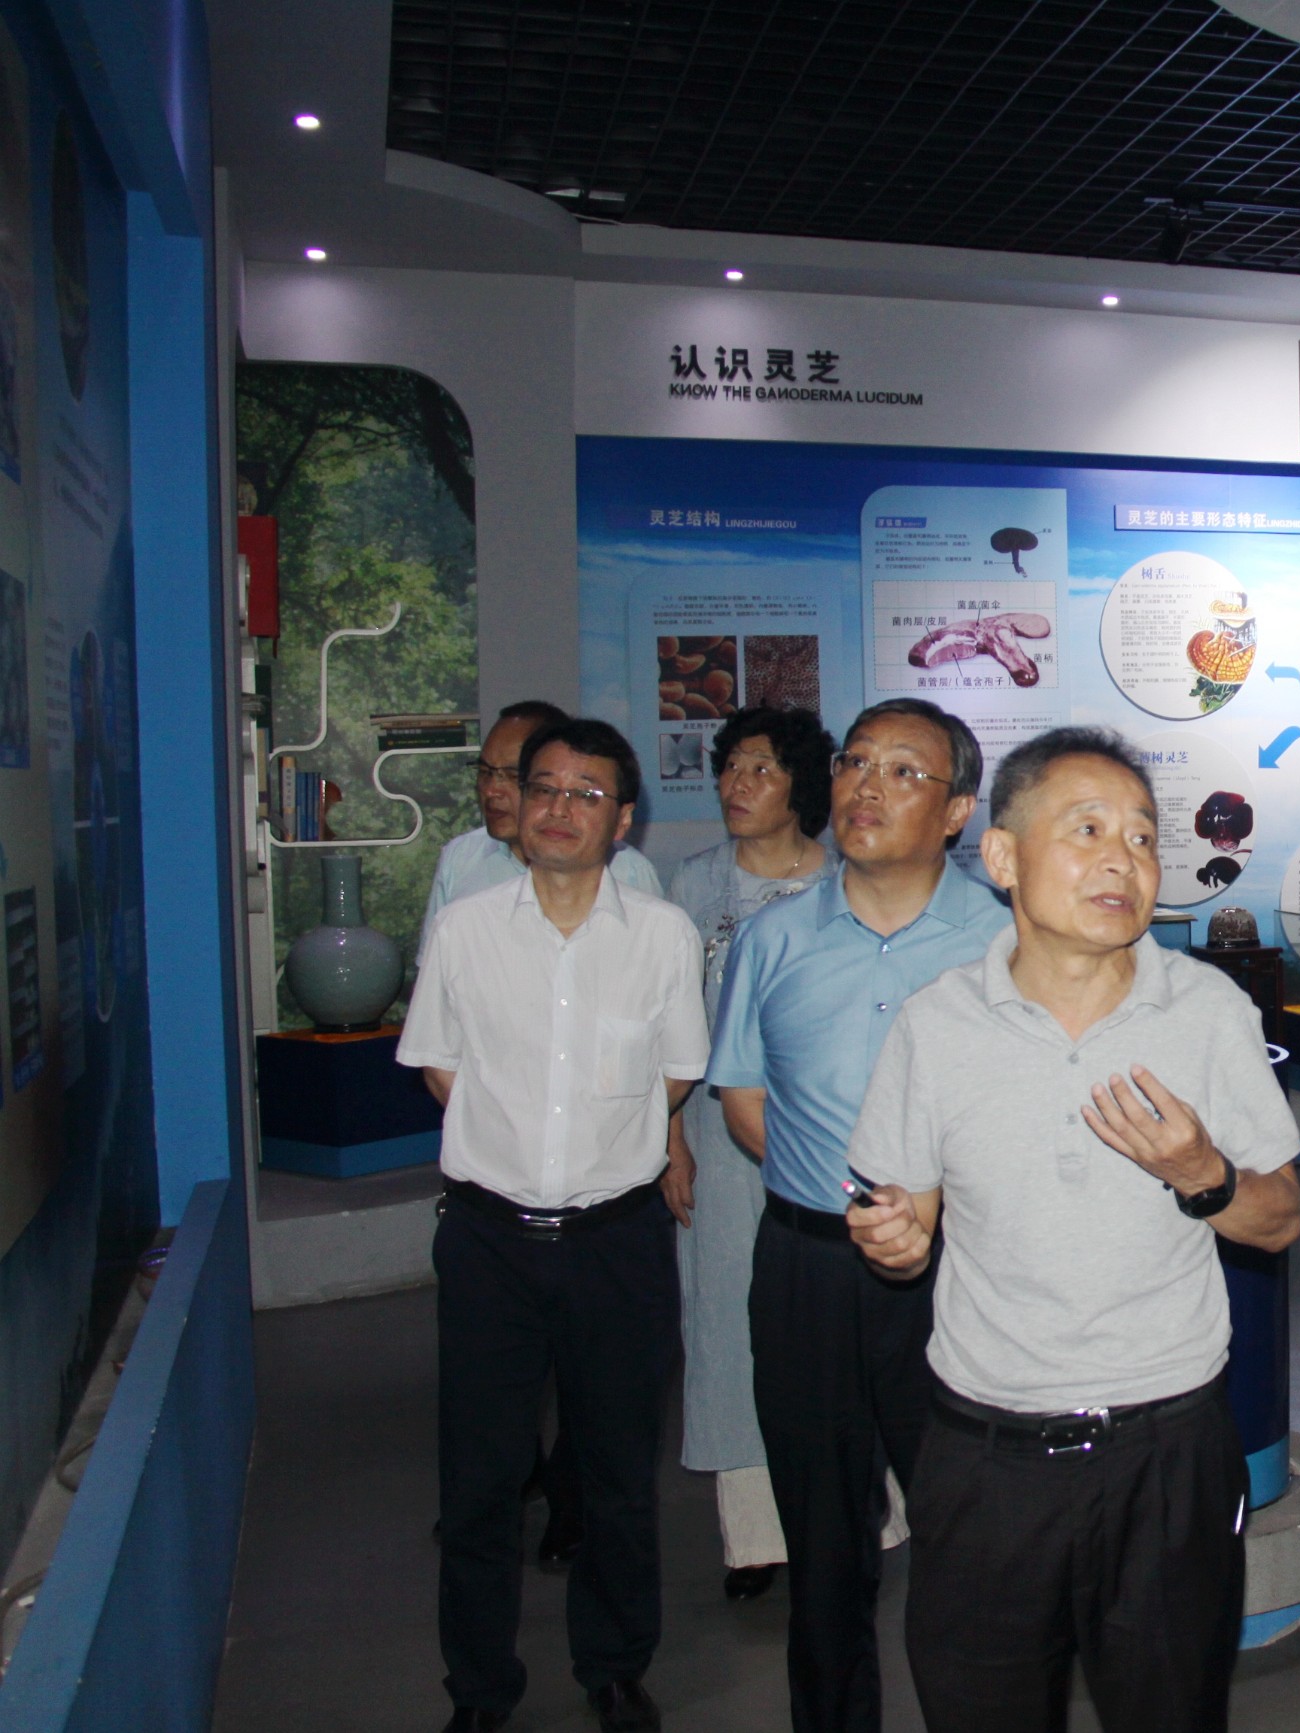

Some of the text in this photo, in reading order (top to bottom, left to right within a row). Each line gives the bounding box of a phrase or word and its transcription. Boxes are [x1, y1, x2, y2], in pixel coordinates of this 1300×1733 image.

[669, 344, 841, 385] 认识灵芝
[722, 385, 752, 401] THE
[754, 387, 853, 404] GANODERMA
[855, 391, 924, 406] LUCIDUM
[649, 509, 721, 527] 灵芝结构
[725, 519, 797, 529] LINGZHIJIEGOU
[1128, 509, 1267, 528] 灵芝的主要形态特征
[1142, 567, 1166, 580] 树舌
[892, 616, 948, 627] 菌肉层/皮层
[1033, 652, 1054, 664] 菌柄
